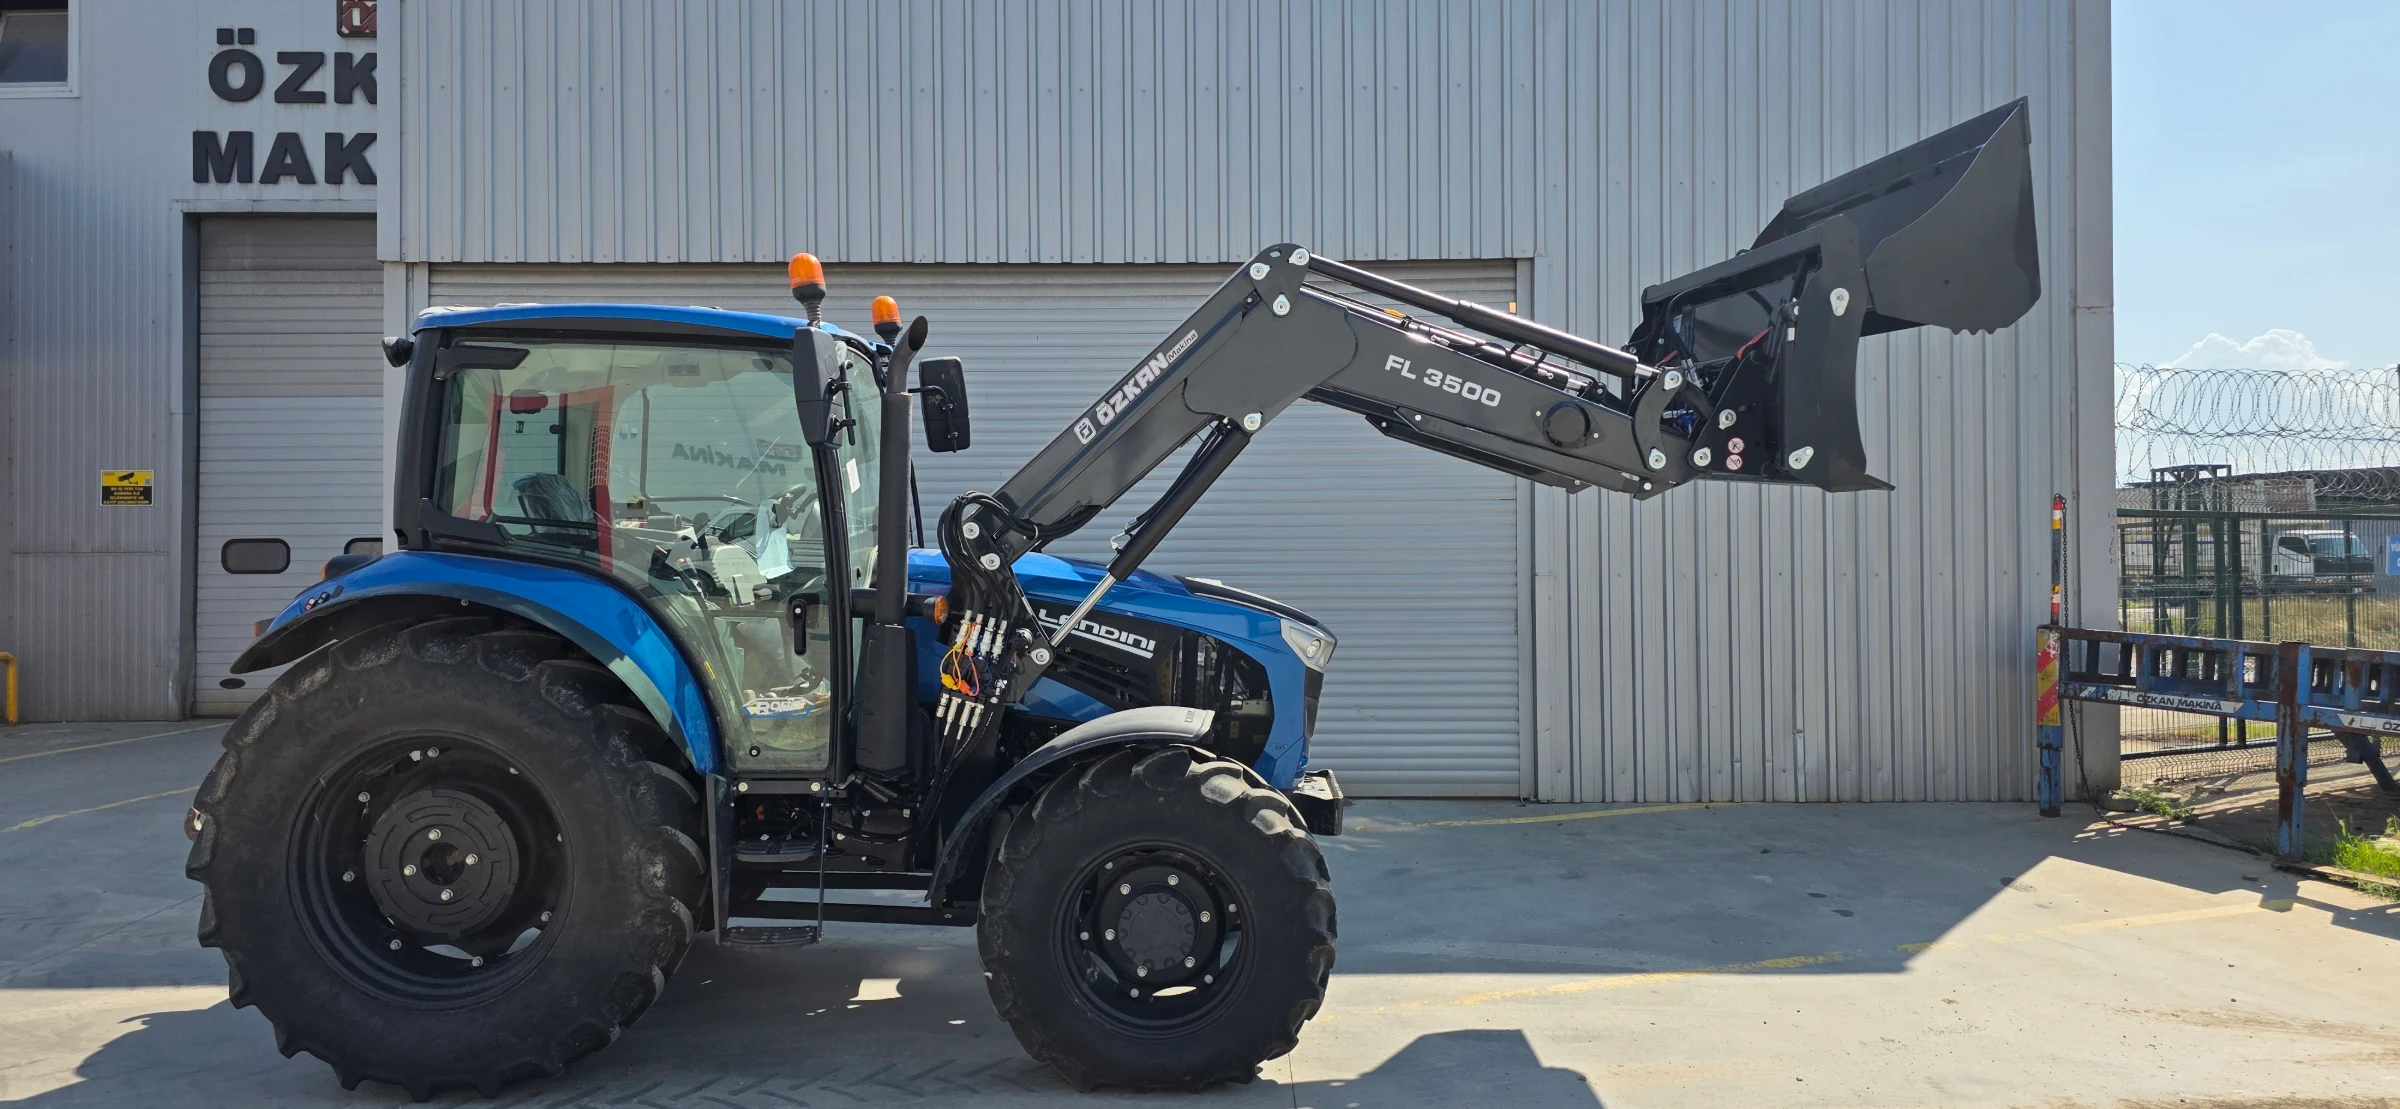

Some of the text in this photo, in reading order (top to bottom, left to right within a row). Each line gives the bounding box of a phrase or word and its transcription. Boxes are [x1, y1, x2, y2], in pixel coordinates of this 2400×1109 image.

[1096, 351, 1169, 426] ÖZKAN
[1385, 354, 1501, 407] FL 3500
[2137, 692, 2222, 711] ÖZKAN MAKİNA
